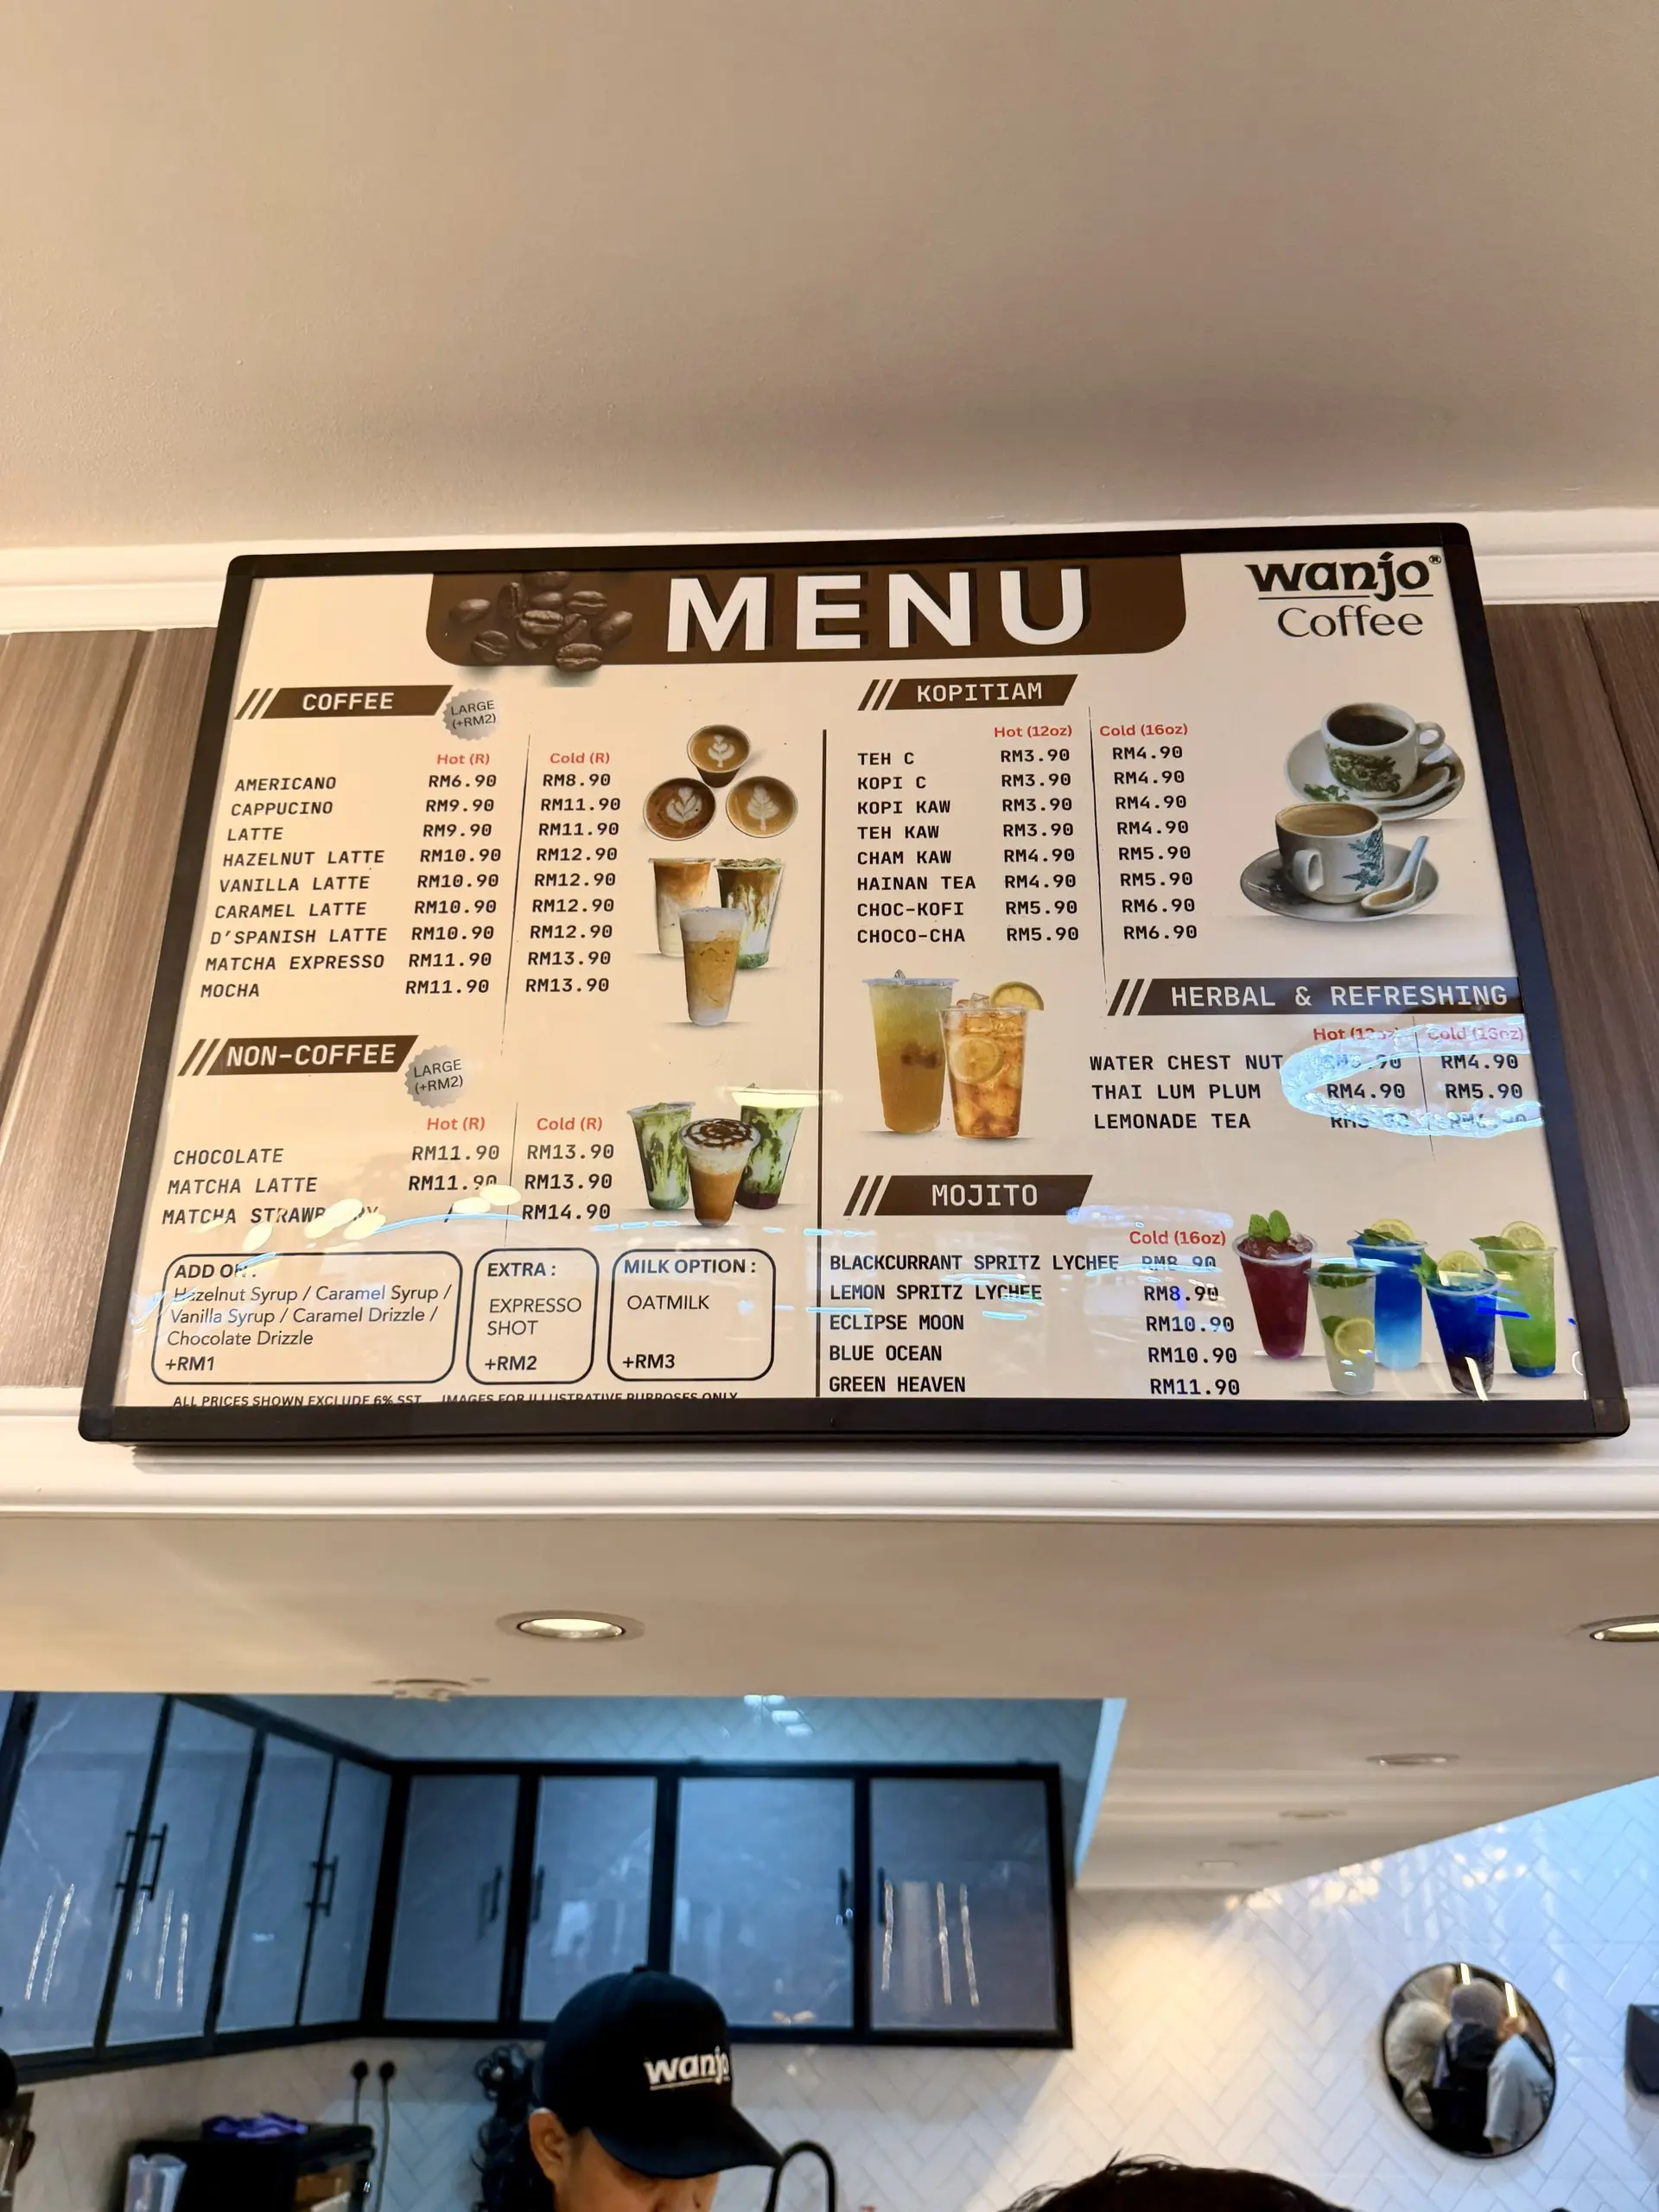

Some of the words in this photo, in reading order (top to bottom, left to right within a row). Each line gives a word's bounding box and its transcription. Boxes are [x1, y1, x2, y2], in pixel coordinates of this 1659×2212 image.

[666, 569, 1087, 653] MENU
[1277, 605, 1424, 639] Coffee
[918, 683, 1041, 702] KOPITIAM
[303, 693, 394, 710] COFFEE
[450, 700, 494, 716] LARGE
[452, 713, 496, 729] (+RM2)
[993, 726, 1022, 739] Hot
[1026, 726, 1072, 739] (12oz)
[1098, 725, 1136, 738] Cold
[1139, 723, 1189, 737] (16oz)
[436, 753, 465, 766] Hot
[468, 752, 490, 766] (R)
[548, 753, 585, 765] Cold
[589, 752, 610, 765] (R)
[858, 753, 891, 765] TEH
[905, 753, 913, 765] C
[1001, 749, 1069, 762] RM3.90
[1113, 746, 1182, 760] RM4.90
[235, 777, 336, 791] AMERICANO
[429, 775, 496, 787] RM6.90
[543, 773, 610, 786] RM8.90
[858, 777, 902, 790] KOPI
[916, 777, 925, 789] C
[1001, 773, 1071, 787] RM3.90
[1114, 771, 1184, 785] RM4.90
[232, 801, 333, 816] CAPPUCINO
[426, 799, 493, 812] RM9.90
[541, 798, 620, 810] RM11.90
[858, 801, 902, 814] KOPI
[917, 800, 950, 813] KAW
[1002, 798, 1071, 811] RM3.90
[1116, 795, 1186, 809] RM4.90
[227, 827, 283, 841] LATTE
[423, 823, 492, 837] RM9.90
[539, 823, 619, 836] RM11.90
[857, 826, 891, 839] TEH
[906, 826, 939, 838] KAW
[1003, 823, 1073, 836] RM3.90
[1117, 821, 1188, 835] RM4.90
[223, 852, 315, 867] HAZELNUT
[327, 850, 385, 864] LATTE
[420, 849, 500, 862] RM10.90
[537, 848, 617, 861] RM12.90
[858, 851, 903, 864] CHAM
[917, 850, 951, 863] KAW
[1004, 849, 1074, 862] RM4.90
[1119, 846, 1190, 860] RM5.90
[220, 878, 299, 893] VANILLA
[313, 876, 370, 890] LATTE
[417, 874, 499, 887] RM10.90
[535, 873, 615, 887] RM12.90
[858, 877, 927, 890] HAINAN
[941, 876, 976, 889] TEA
[1005, 874, 1076, 888] RM4.90
[1121, 872, 1192, 887] RM5.90
[215, 904, 295, 918] CARAMEL
[309, 902, 366, 916] LATTE
[415, 899, 496, 913] RM10.90
[532, 899, 613, 912] RM12.90
[858, 902, 963, 917] CHOC-KOFI
[1006, 900, 1077, 914] RM5.90
[1122, 899, 1194, 912] RM6.90
[329, 928, 387, 942] LATTE
[412, 926, 493, 940] RM10.90
[531, 925, 612, 938] RM12.90
[858, 929, 965, 943] CHOCO-CHA
[1007, 927, 1078, 941] RM5.90
[1124, 925, 1197, 939] RM6.90
[206, 957, 276, 970] MATCHA
[289, 955, 384, 969] EXPRESSO
[409, 952, 492, 967] RM11.90
[528, 951, 610, 965] RM13.90
[200, 983, 259, 997] MOCHA
[406, 979, 489, 994] RM11.90
[526, 978, 608, 992] RM13.90
[1172, 987, 1275, 1007] HERBAL
[1295, 986, 1312, 1006] &
[1331, 986, 1507, 1006] REFRESHING
[1313, 1029, 1344, 1041] Hot
[227, 1044, 396, 1066] NON-COFFEE
[1441, 1054, 1518, 1069] RM4.90
[414, 1058, 463, 1079] LARGE
[1090, 1056, 1154, 1071] WATER
[1168, 1055, 1230, 1070] CHEST
[1246, 1055, 1283, 1070] NUT
[415, 1075, 462, 1095] (+RM2)
[1092, 1084, 1141, 1099] THAI
[1158, 1084, 1194, 1099] LUM
[1209, 1084, 1261, 1098] PLUM
[1326, 1084, 1405, 1098] RM4.90
[1446, 1084, 1522, 1099] RM5.90
[425, 1117, 457, 1130] Hot
[462, 1116, 486, 1133] (R)
[537, 1116, 575, 1132] Cold
[580, 1116, 603, 1132] (R)
[1095, 1114, 1197, 1128] LEMONADE
[1211, 1114, 1250, 1128] TEA
[174, 1148, 283, 1165] CHOCOLATE
[412, 1145, 499, 1160] RM11.90
[527, 1144, 613, 1160] RM13.90
[168, 1179, 240, 1194] MATCHA
[256, 1177, 317, 1192] LATTE
[524, 1173, 612, 1189] RM13.90
[932, 1185, 1037, 1206] MOJITO
[162, 1209, 236, 1224] MATCHA
[523, 1204, 610, 1219] RM14.90
[1128, 1230, 1169, 1246] Cold
[1173, 1230, 1226, 1247] (16oz)
[487, 1262, 546, 1276] EXTRA
[625, 1260, 670, 1274] MILK
[675, 1259, 745, 1273] OPTION
[830, 1255, 963, 1269] BLACKCURRANT
[975, 1255, 1040, 1269] SPRITZ
[1053, 1255, 1118, 1270] LYCHEE
[175, 1264, 214, 1278] ADD
[251, 1287, 297, 1305] Syrup
[316, 1285, 385, 1300] Caramel
[391, 1285, 438, 1304] Syrup
[831, 1285, 885, 1300] LEMON
[897, 1285, 963, 1300] SPRITZ
[976, 1284, 1041, 1300] LYCHEE
[1144, 1286, 1218, 1301] RM8.90
[490, 1298, 582, 1313] EXPRESSO
[627, 1295, 709, 1310] OATMILK
[171, 1308, 221, 1323] Vanilla
[228, 1309, 275, 1327] Syrup
[293, 1306, 363, 1323] Caramel
[369, 1306, 424, 1321] Drizzle
[830, 1314, 907, 1330] ECLIPSE
[919, 1315, 963, 1330] MOON
[487, 1320, 538, 1336] SHOT
[1147, 1316, 1234, 1332] RM10.90
[168, 1330, 251, 1345] Chocolate
[257, 1330, 313, 1344] Drizzle
[830, 1345, 874, 1361] BLUE
[886, 1345, 941, 1361] OCEAN
[1148, 1347, 1236, 1363] RM10.90
[166, 1357, 214, 1370] +RM1
[485, 1356, 537, 1370] +RM2
[623, 1354, 675, 1369] +RM3
[830, 1376, 885, 1392] GREEN
[898, 1376, 965, 1392] HEAVEN
[1151, 1379, 1239, 1395] RM11.90
[174, 1395, 197, 1407] ALL
[201, 1395, 248, 1407] PRICES
[252, 1395, 303, 1406] SHOWN
[643, 2045, 729, 2085] wanjo
